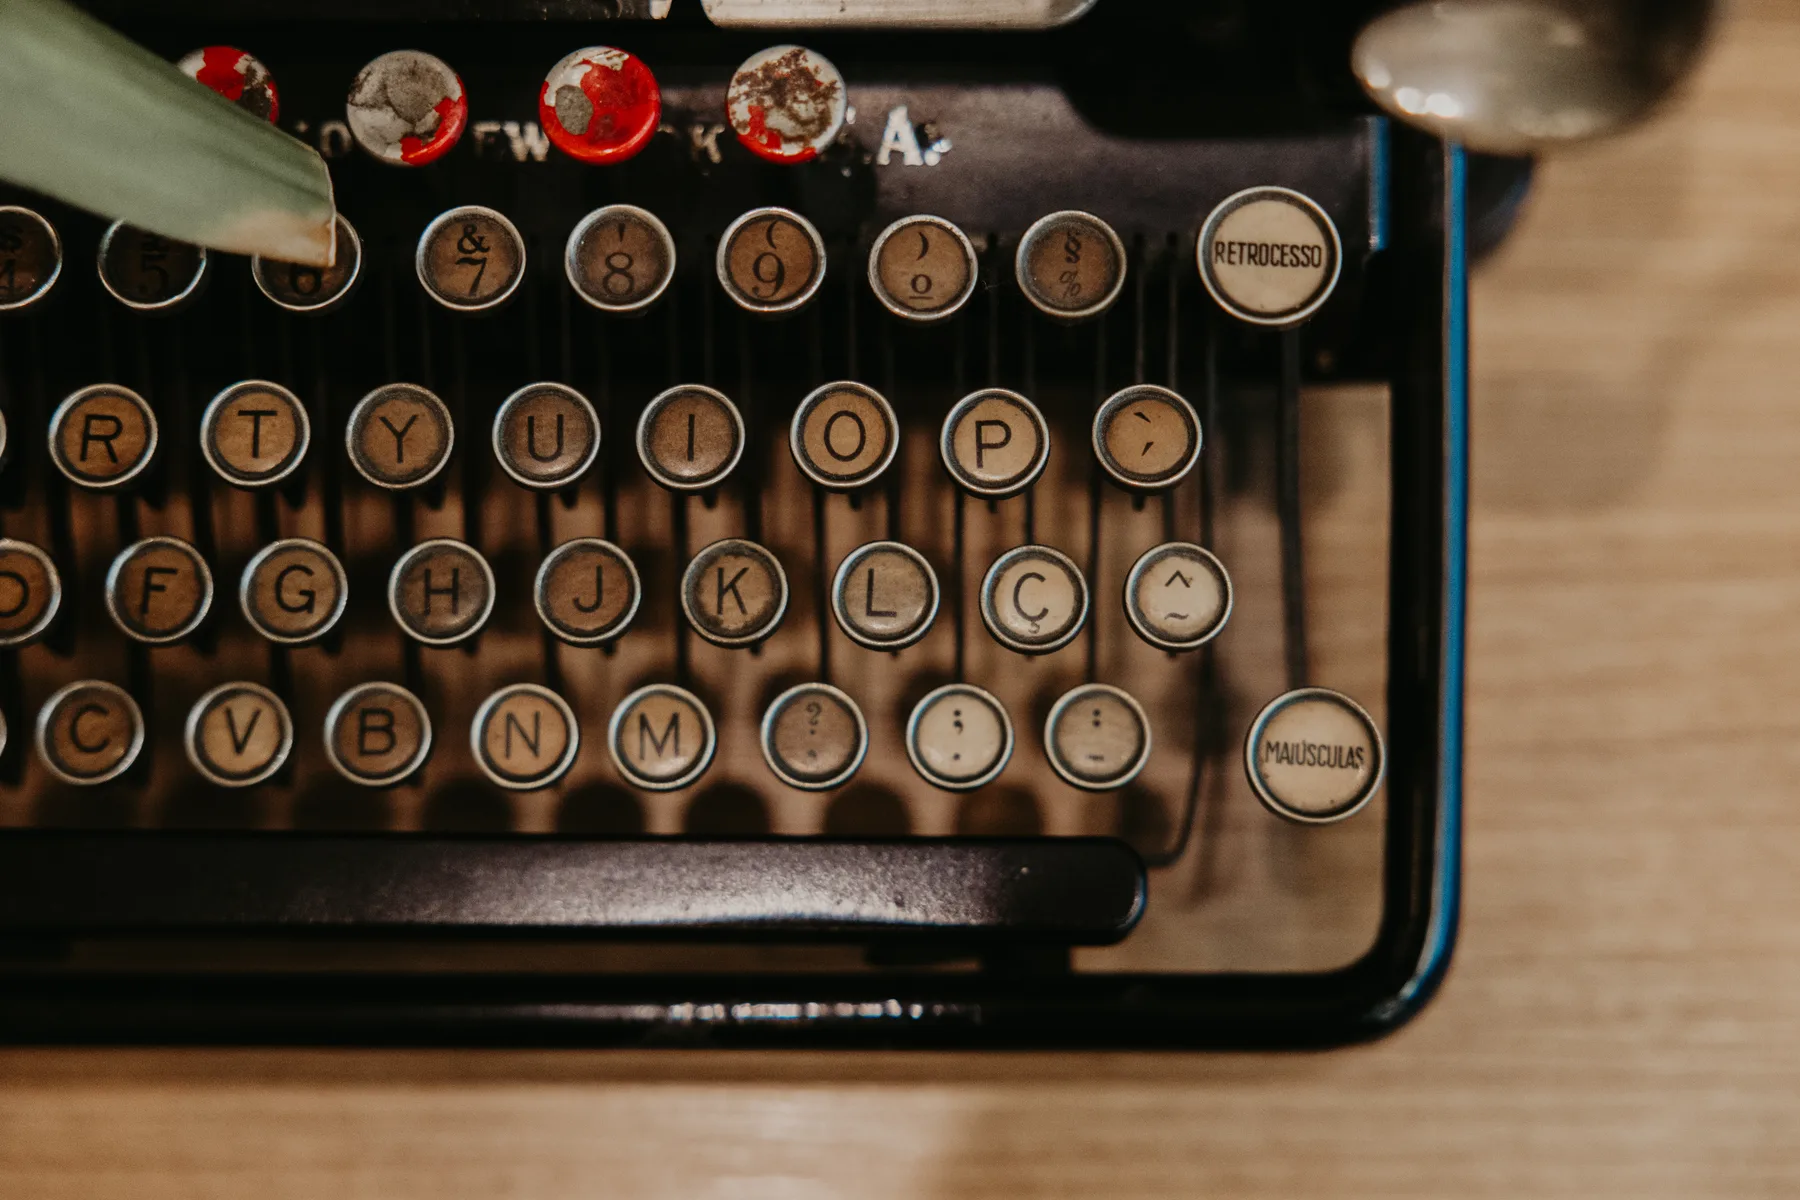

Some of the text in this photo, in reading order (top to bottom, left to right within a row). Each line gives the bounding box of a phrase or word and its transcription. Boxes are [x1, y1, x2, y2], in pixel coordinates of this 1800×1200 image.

[457, 223, 491, 254] &
[1214, 240, 1322, 268] RETROCESSO
[455, 256, 488, 298] 7
[603, 253, 634, 298] 8
[751, 252, 786, 299] 9
[80, 414, 125, 466] R
[237, 409, 278, 459] T
[378, 414, 419, 463] Y
[525, 415, 564, 463] U
[823, 410, 866, 462] O
[975, 419, 1012, 468] P
[140, 566, 179, 615] F
[273, 563, 316, 614] G
[423, 567, 460, 617] H
[573, 564, 603, 613] J
[716, 566, 749, 615] K
[865, 568, 896, 617] L
[1011, 571, 1050, 635] Ç
[70, 702, 111, 753] C
[224, 707, 261, 756] V
[358, 708, 397, 757] B
[504, 710, 541, 759] N
[638, 711, 681, 760] M
